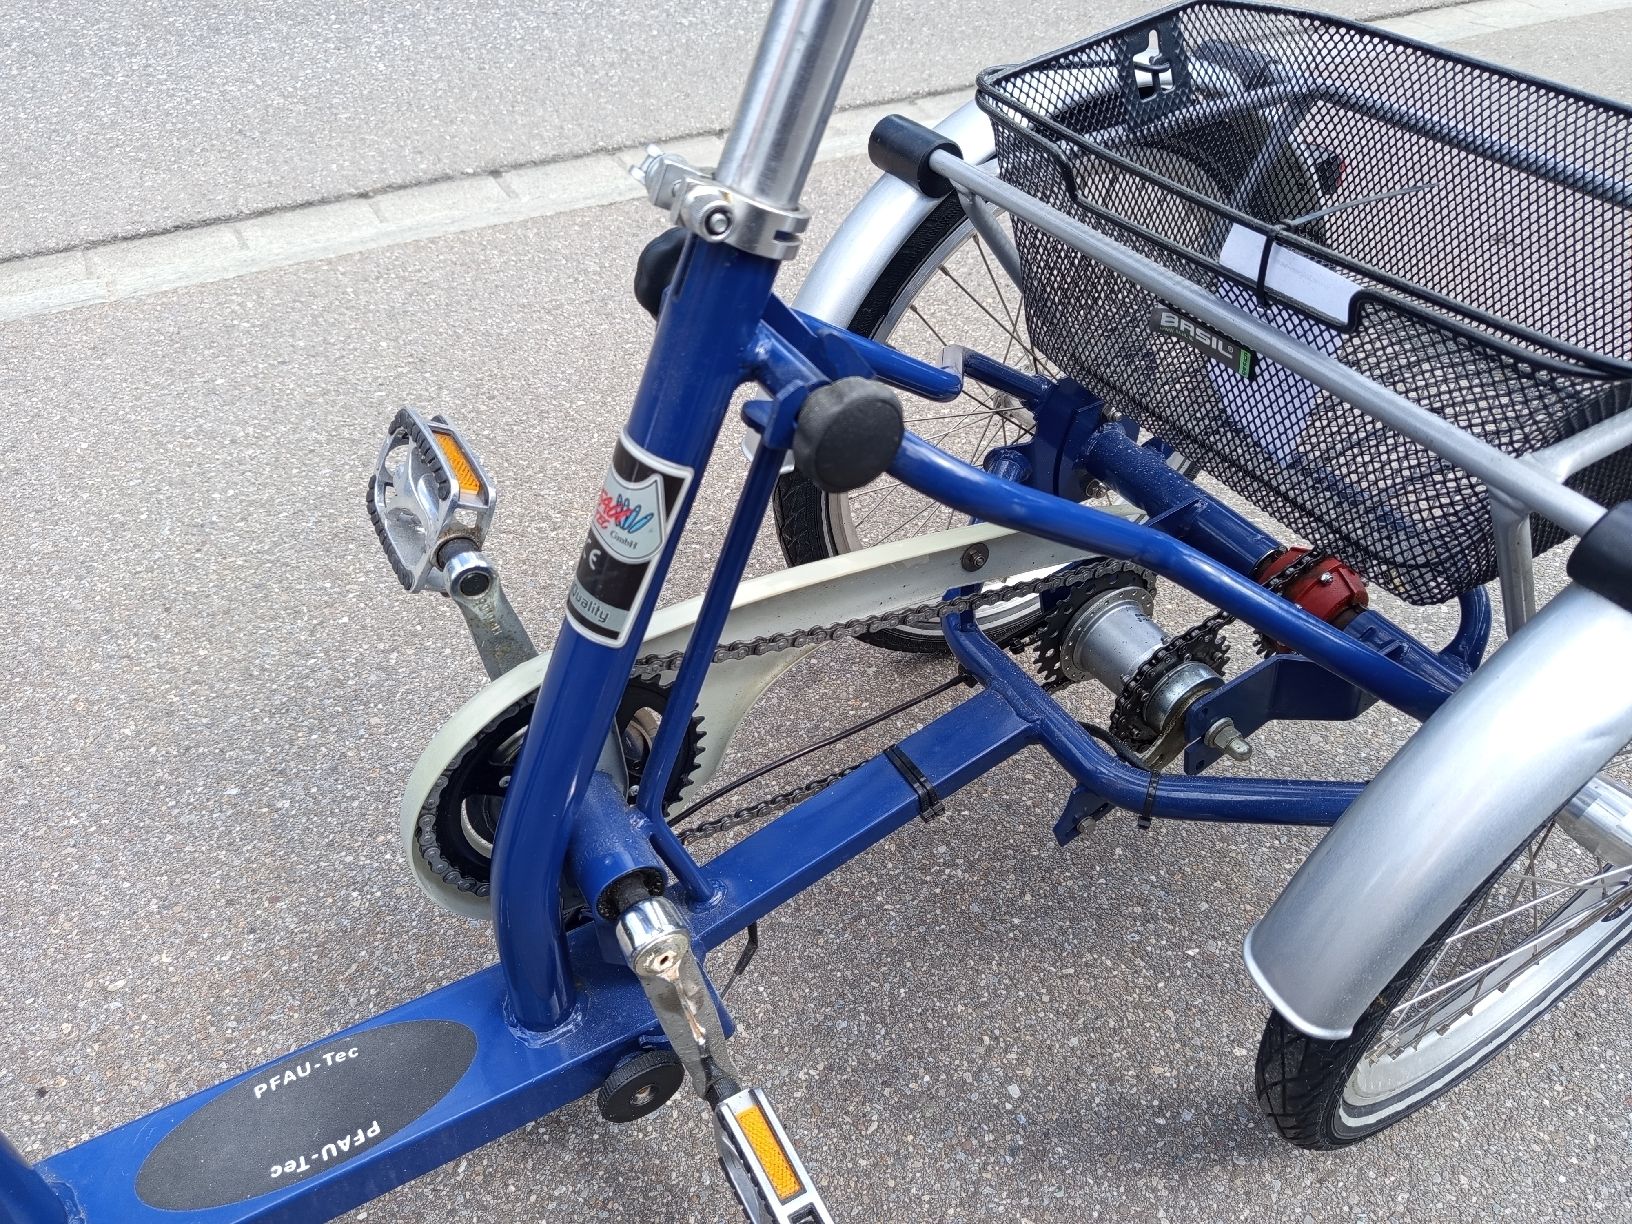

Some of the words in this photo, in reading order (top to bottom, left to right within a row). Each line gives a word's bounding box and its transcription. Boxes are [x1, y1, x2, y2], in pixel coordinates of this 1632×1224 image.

[1160, 312, 1233, 358] BASIL
[610, 530, 639, 550] GmbH
[570, 583, 609, 623] Quality
[253, 1047, 359, 1099] PFAU-Tec
[270, 1120, 381, 1178] PFAU-Tec
